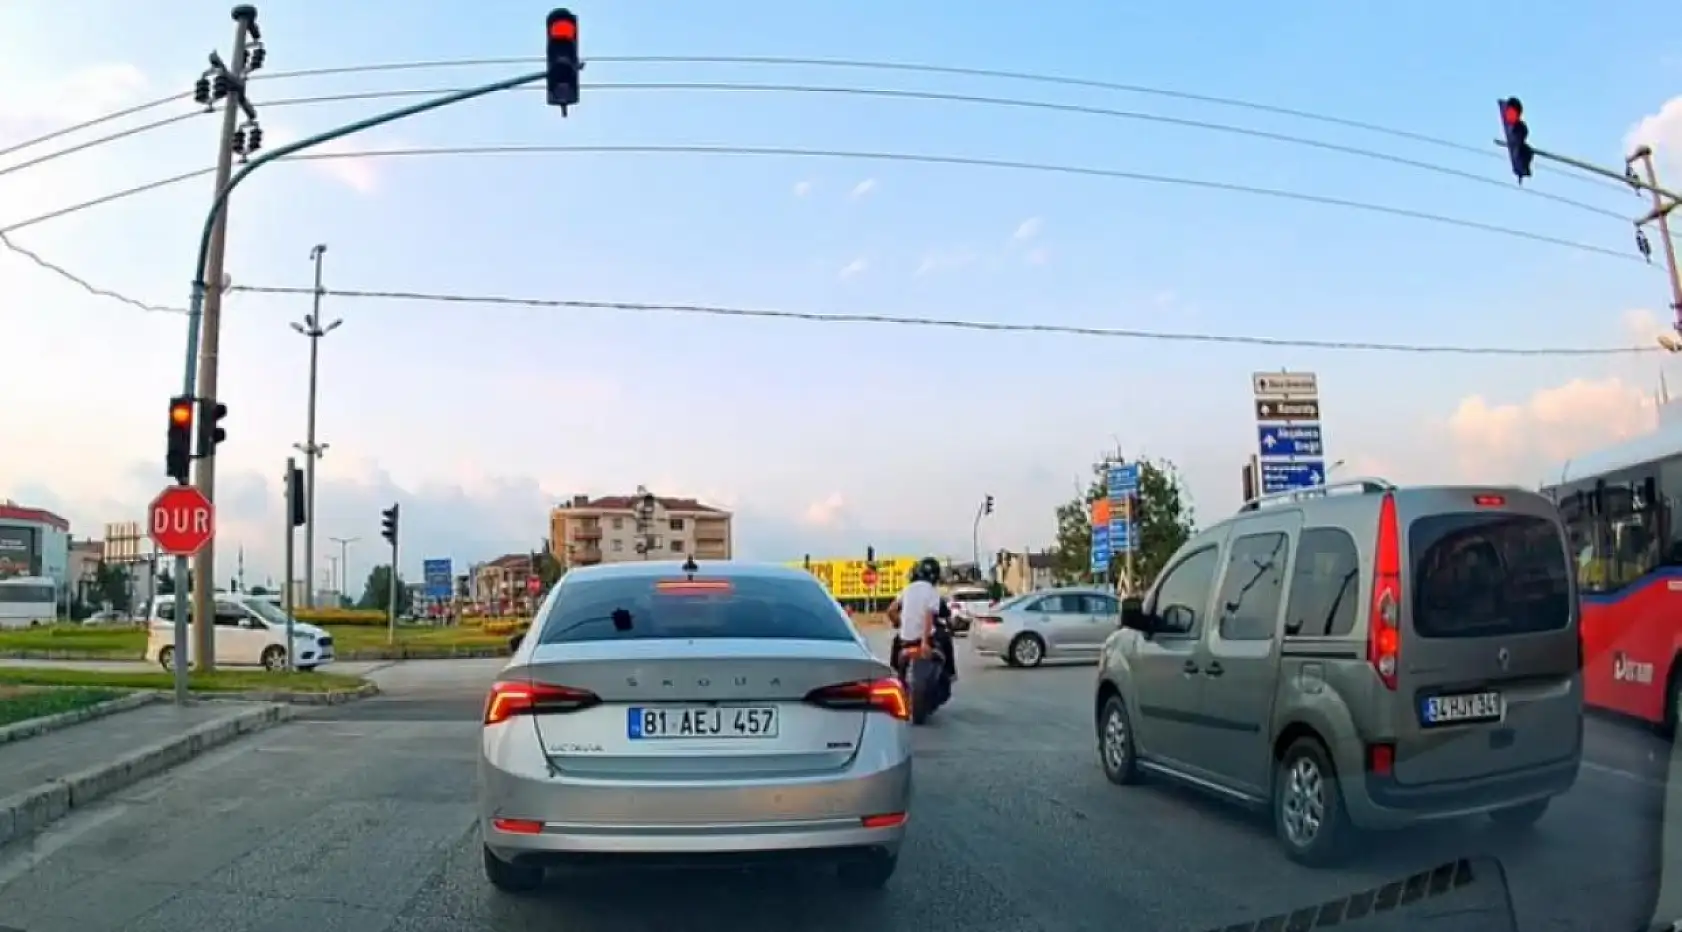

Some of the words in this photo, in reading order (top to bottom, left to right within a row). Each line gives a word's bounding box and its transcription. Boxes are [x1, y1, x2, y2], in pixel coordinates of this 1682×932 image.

[154, 506, 209, 534] DUR
[644, 711, 666, 734] 81
[680, 711, 721, 734] AEJ
[734, 711, 774, 734] 457
